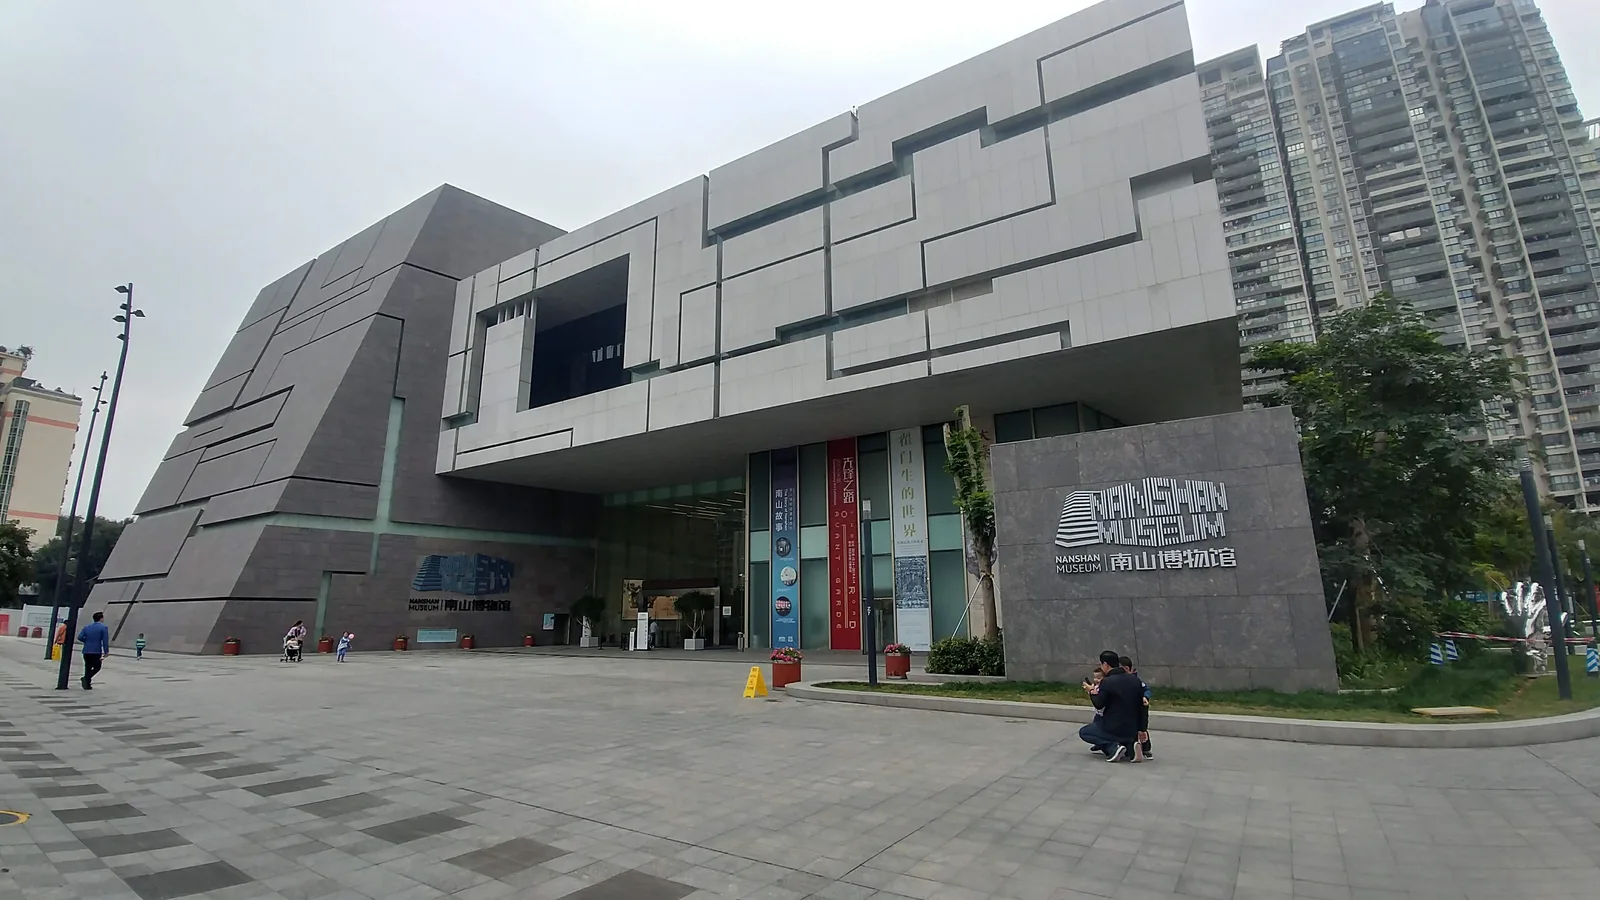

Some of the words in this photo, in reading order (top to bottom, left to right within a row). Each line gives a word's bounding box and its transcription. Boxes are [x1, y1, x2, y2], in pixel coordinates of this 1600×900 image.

[775, 489, 783, 532] 南山故事
[1090, 477, 1229, 520] NANSHAN
[1096, 513, 1226, 547] MUSEUM
[1055, 554, 1101, 564] NANSHAN
[1056, 563, 1102, 574] MUSEUM
[1109, 548, 1237, 572] 南山博物馆
[444, 599, 511, 612] 南山博物馆
